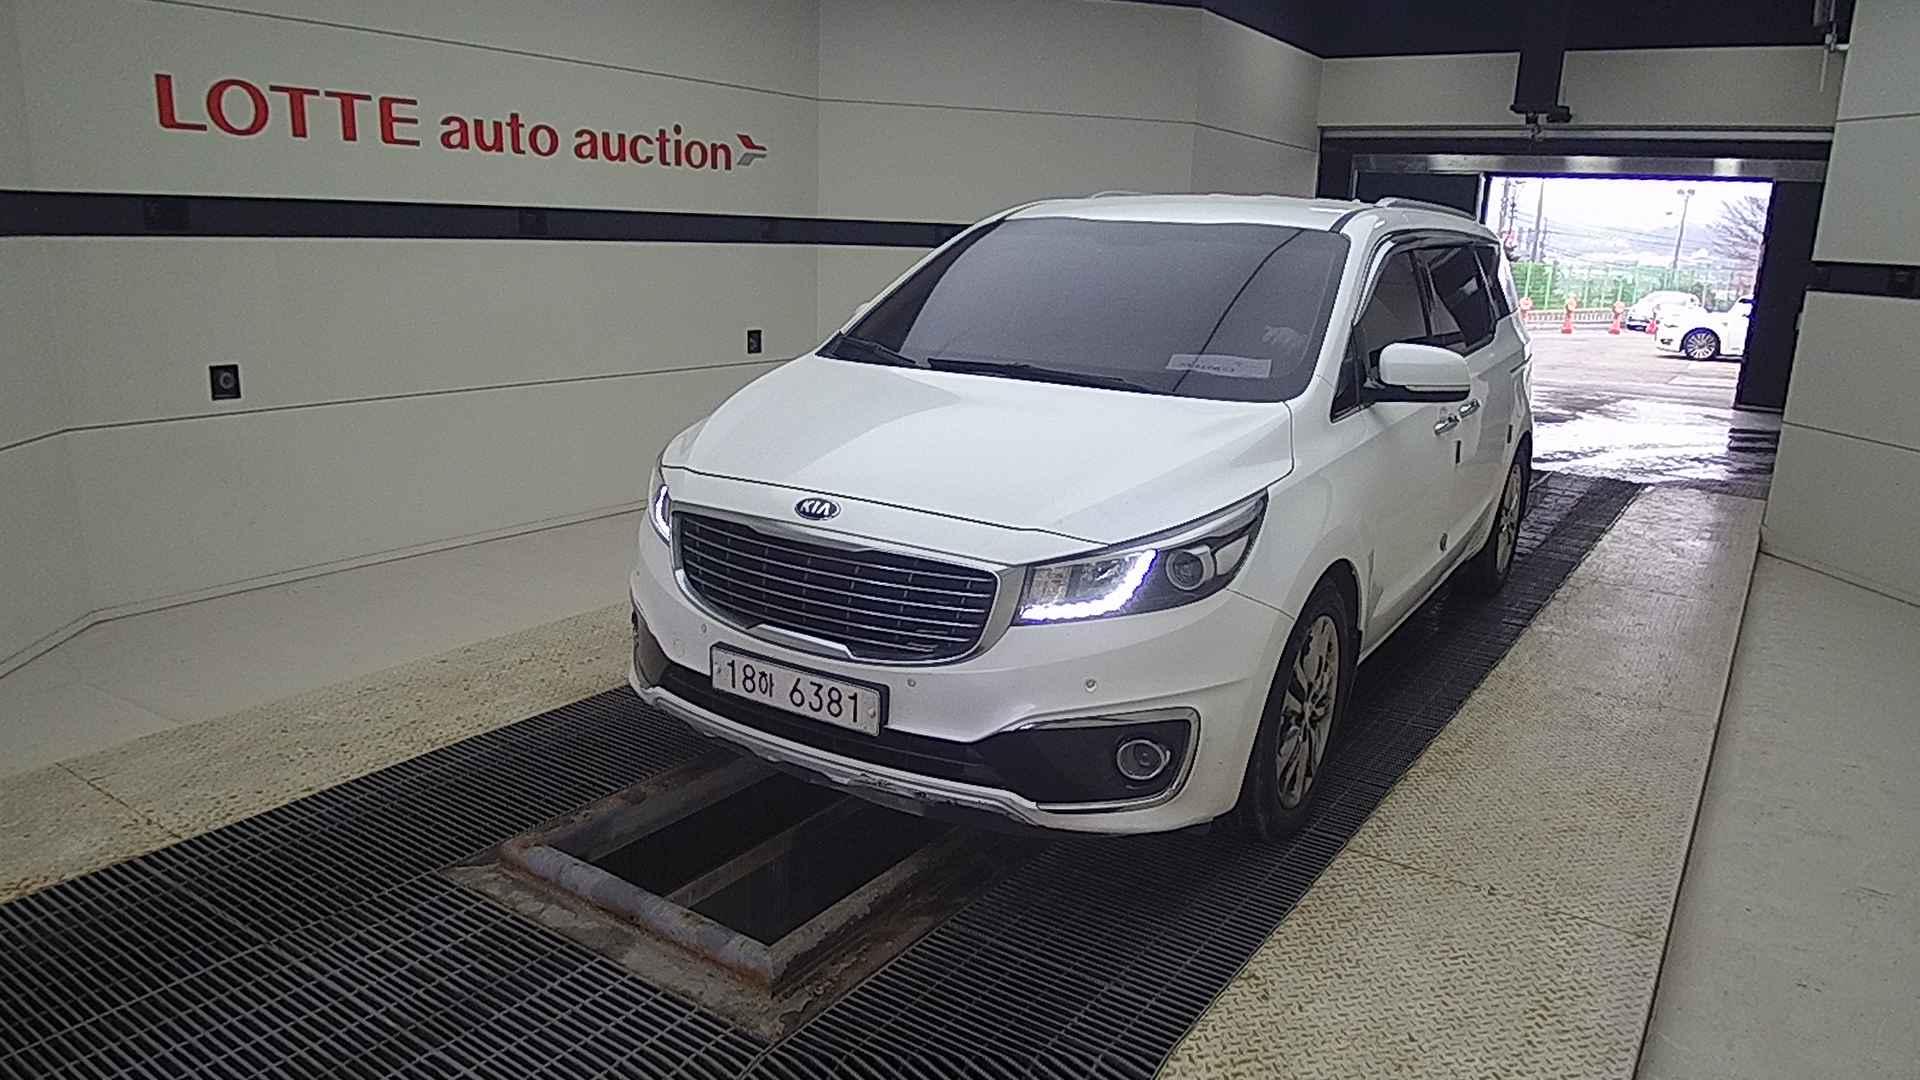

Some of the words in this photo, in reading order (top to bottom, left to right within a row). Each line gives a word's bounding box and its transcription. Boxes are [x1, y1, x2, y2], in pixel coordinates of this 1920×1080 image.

[154, 74, 420, 147] LOTTE
[440, 112, 560, 157] auto
[574, 124, 733, 171] auction
[800, 500, 830, 516] KIA
[727, 659, 775, 698] 18하
[789, 677, 858, 723] 6381
